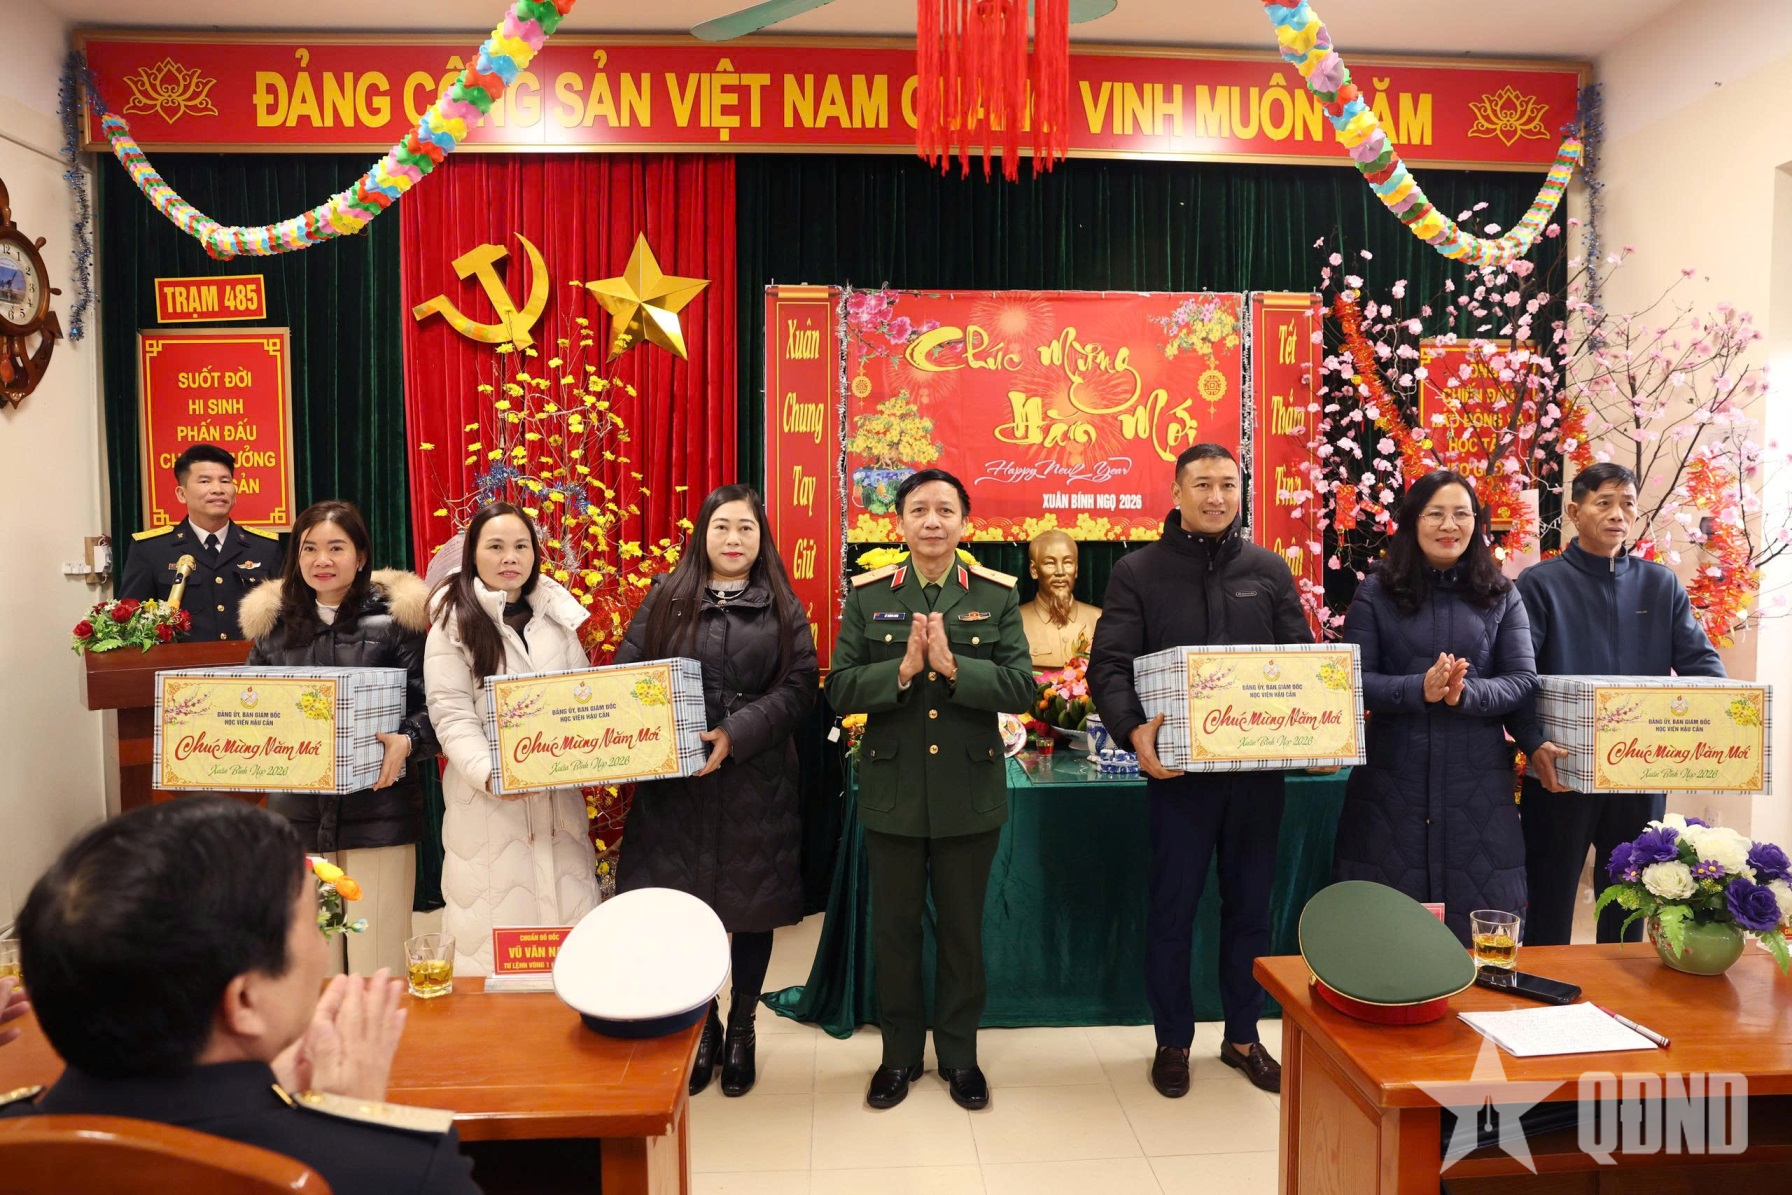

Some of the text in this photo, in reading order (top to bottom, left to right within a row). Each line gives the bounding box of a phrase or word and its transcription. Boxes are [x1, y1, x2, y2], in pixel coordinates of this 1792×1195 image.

[253, 48, 391, 128] ĐẢNG
[403, 56, 541, 127] CG
[555, 49, 651, 128] SẢN
[665, 58, 771, 141] VIỆT
[783, 73, 889, 128] NAM
[1079, 80, 1183, 137] VINH
[1195, 72, 1323, 142] MUÔN
[1335, 77, 1432, 145] ĂM
[163, 284, 258, 319] TRẠM 485
[785, 317, 820, 360] Xuân
[904, 324, 1023, 373] Chúc
[1278, 318, 1298, 365] Tết
[178, 365, 252, 389] SUỐT ĐỜI
[188, 398, 244, 415] HI SINH
[783, 392, 824, 444] Chung
[177, 418, 257, 442] PHẤN ĐẤU
[974, 459, 1046, 485] Happy
[1066, 457, 1132, 485] Year
[792, 465, 816, 517] Tay
[1042, 491, 1142, 511] XUÂN BÍNH NGỌ 2026
[1202, 704, 1249, 735] Chúc
[1249, 710, 1285, 731] Mừng
[1284, 707, 1318, 731] Năm
[175, 731, 224, 761] Chúc
[221, 737, 260, 760] Mừng
[258, 736, 293, 760] Năm
[513, 730, 559, 764] Chúc
[560, 734, 599, 754] Mừng
[598, 727, 634, 750] Năm
[1293, 735, 1314, 746] 2026
[1607, 737, 1652, 765] Chúc
[1653, 744, 1690, 764] Mừng
[1689, 741, 1724, 764] Năm
[267, 765, 289, 776] 2026
[608, 755, 631, 768] 2026
[1696, 768, 1719, 779] 2026
[508, 945, 522, 958] VŨ
[524, 944, 546, 958] VĂN
